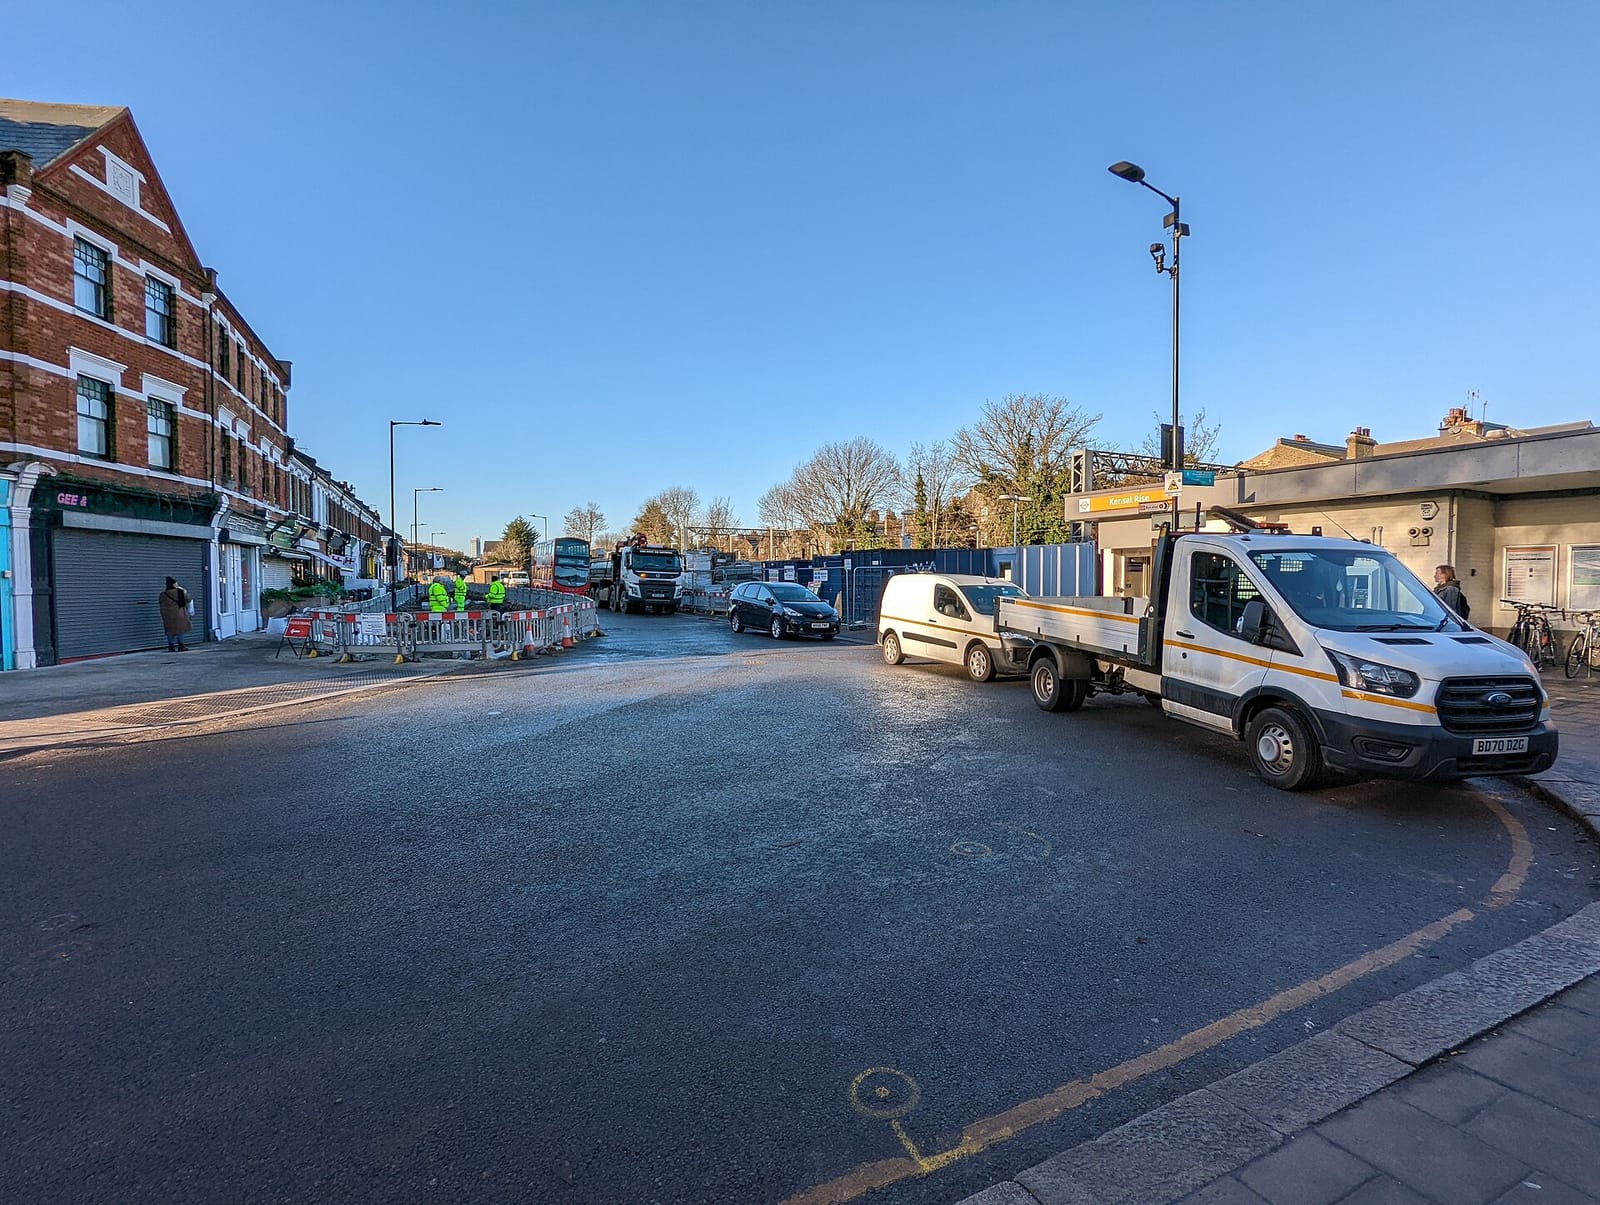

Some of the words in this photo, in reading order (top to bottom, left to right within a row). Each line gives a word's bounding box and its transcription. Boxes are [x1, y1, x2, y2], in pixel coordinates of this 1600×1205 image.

[57, 493, 78, 506] GEE
[80, 496, 87, 507] &
[1109, 496, 1132, 505] Kensal
[1134, 495, 1150, 503] Rise
[1477, 740, 1505, 753] BD70
[1506, 739, 1524, 751] DZG
